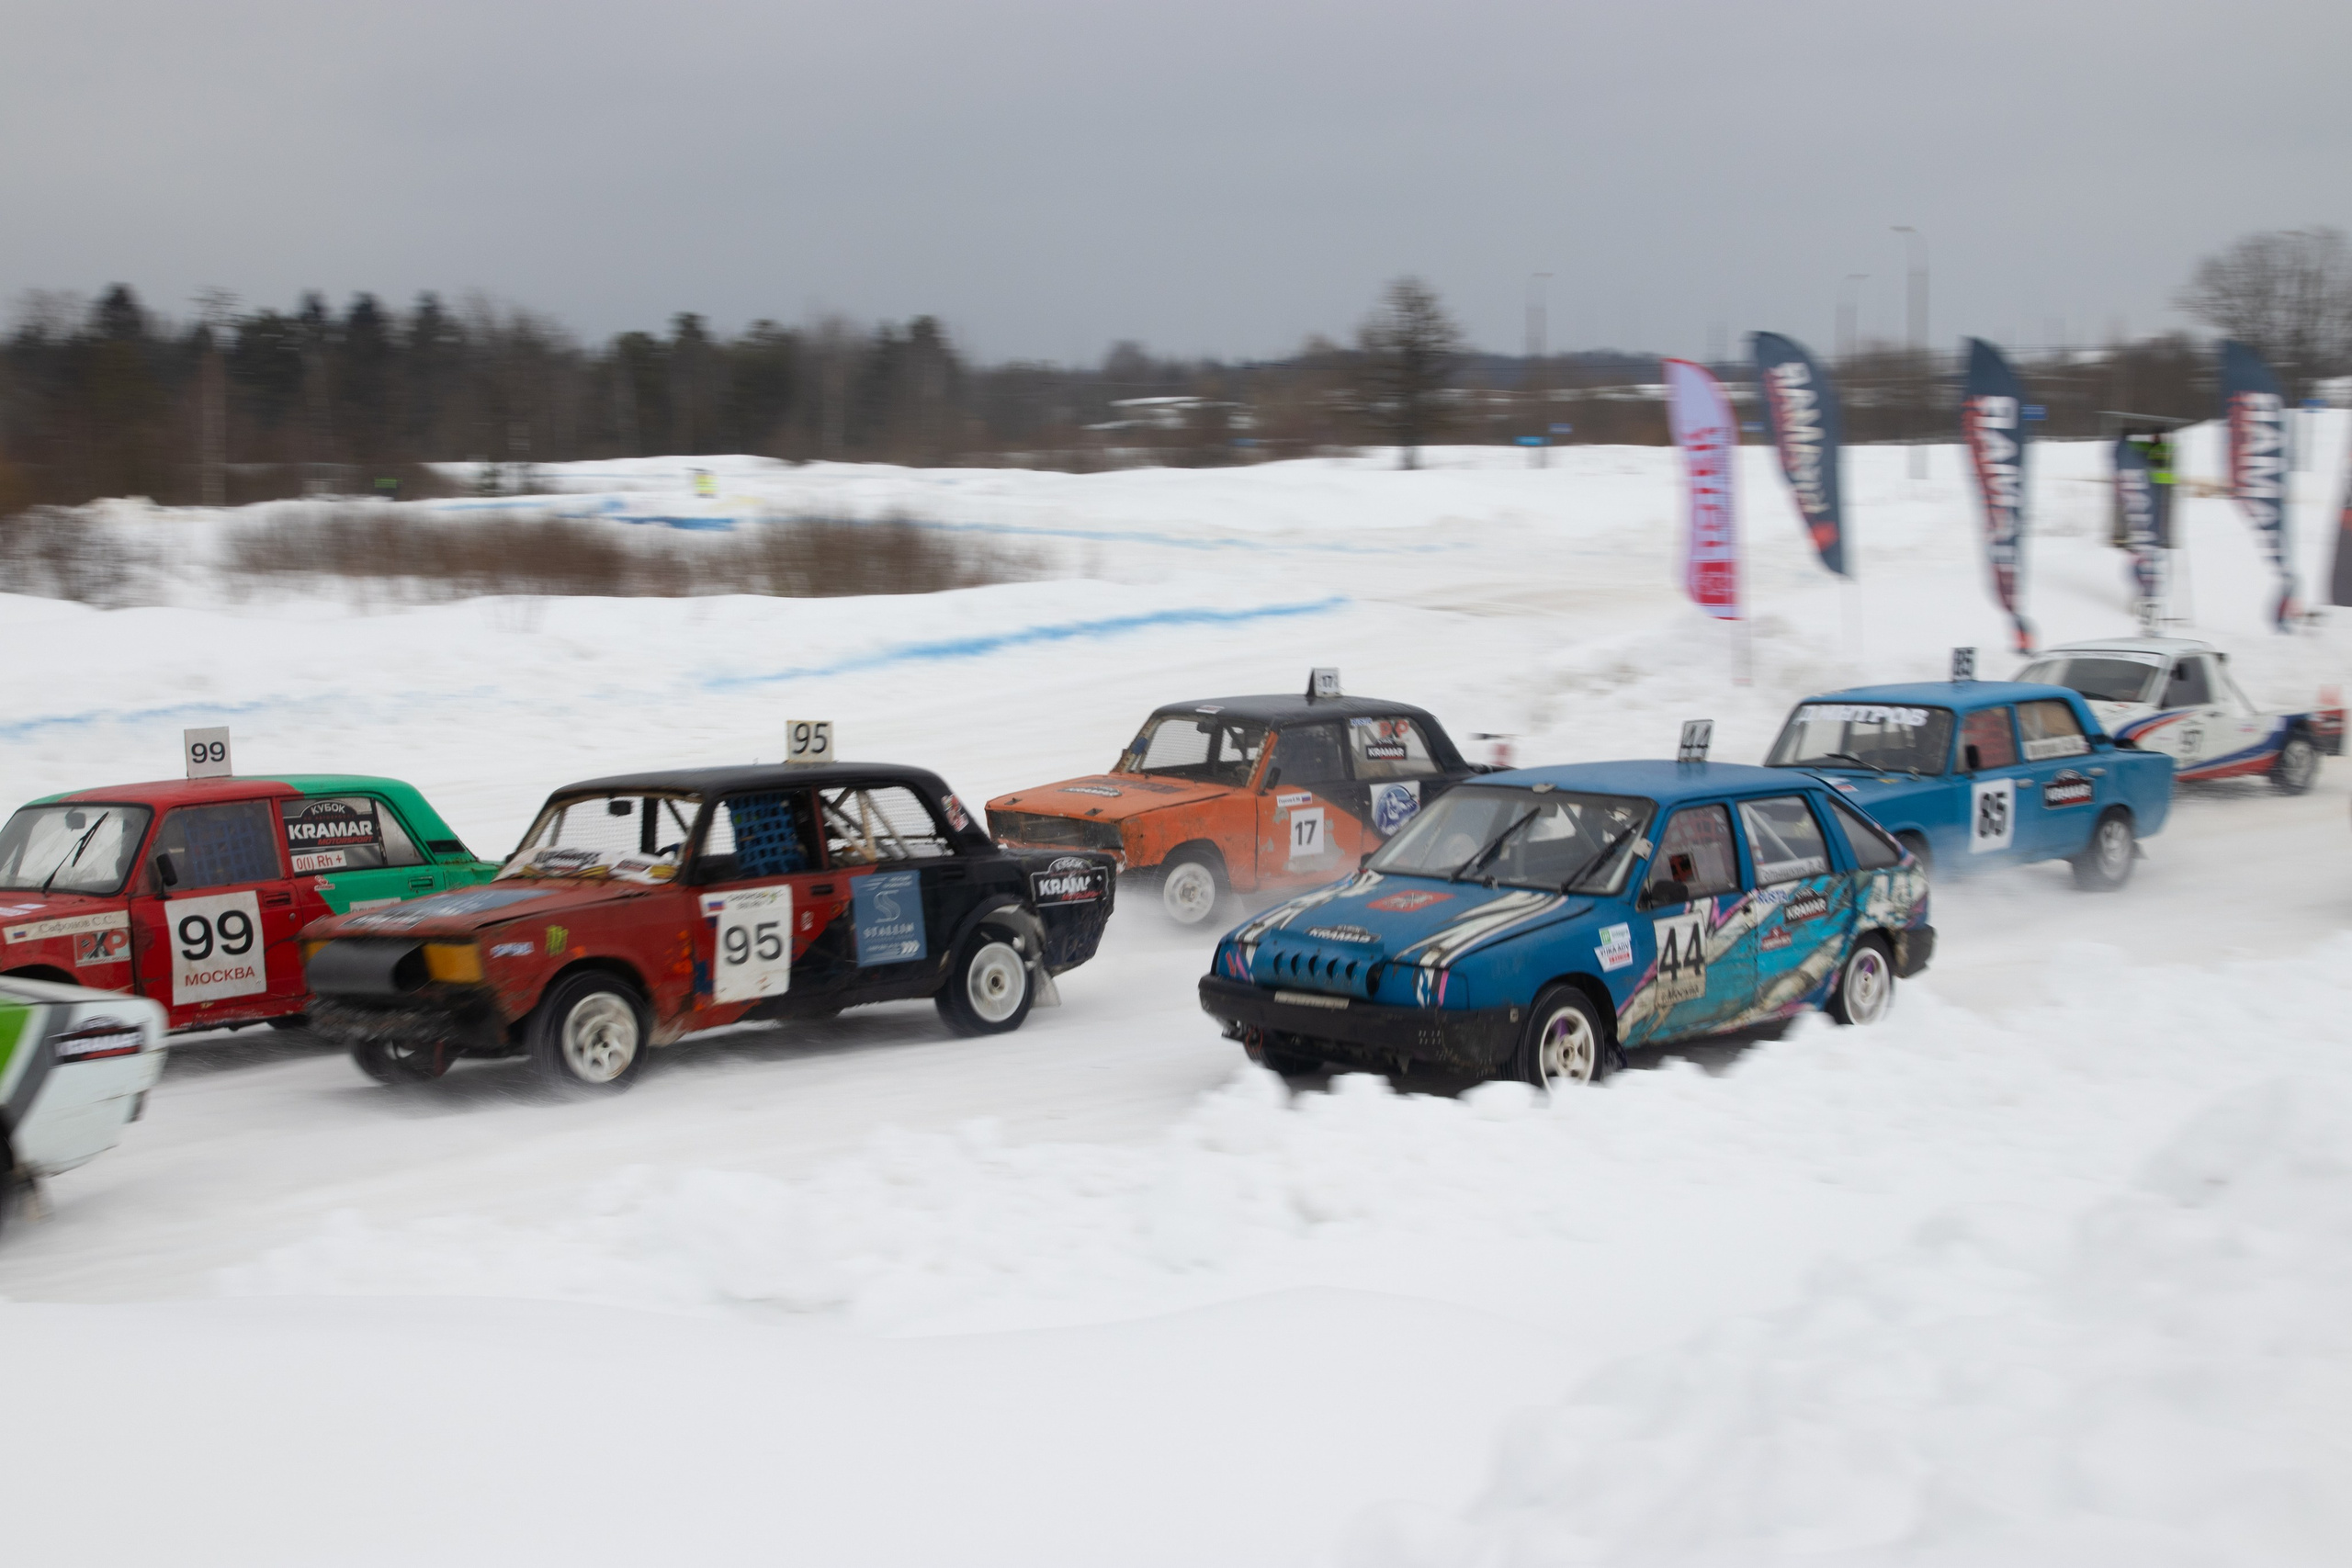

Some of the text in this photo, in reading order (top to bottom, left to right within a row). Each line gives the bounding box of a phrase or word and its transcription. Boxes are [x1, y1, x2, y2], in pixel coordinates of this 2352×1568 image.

[793, 723, 829, 754] 95
[1681, 725, 1711, 758] 44
[191, 741, 226, 764] 99
[1367, 747, 1405, 758] KRAMAR
[311, 803, 346, 815] КУБОК
[1978, 790, 2007, 839] 85
[288, 820, 374, 840] KRAMAR
[317, 835, 373, 846] MOTORSPORT
[1295, 819, 1317, 846] 17
[316, 854, 334, 867] Rh
[1785, 898, 1826, 920] KRAMAR
[178, 909, 254, 961] 99
[724, 921, 783, 965] 95
[1658, 921, 1704, 981] 44
[185, 965, 255, 987] МОСКВА
